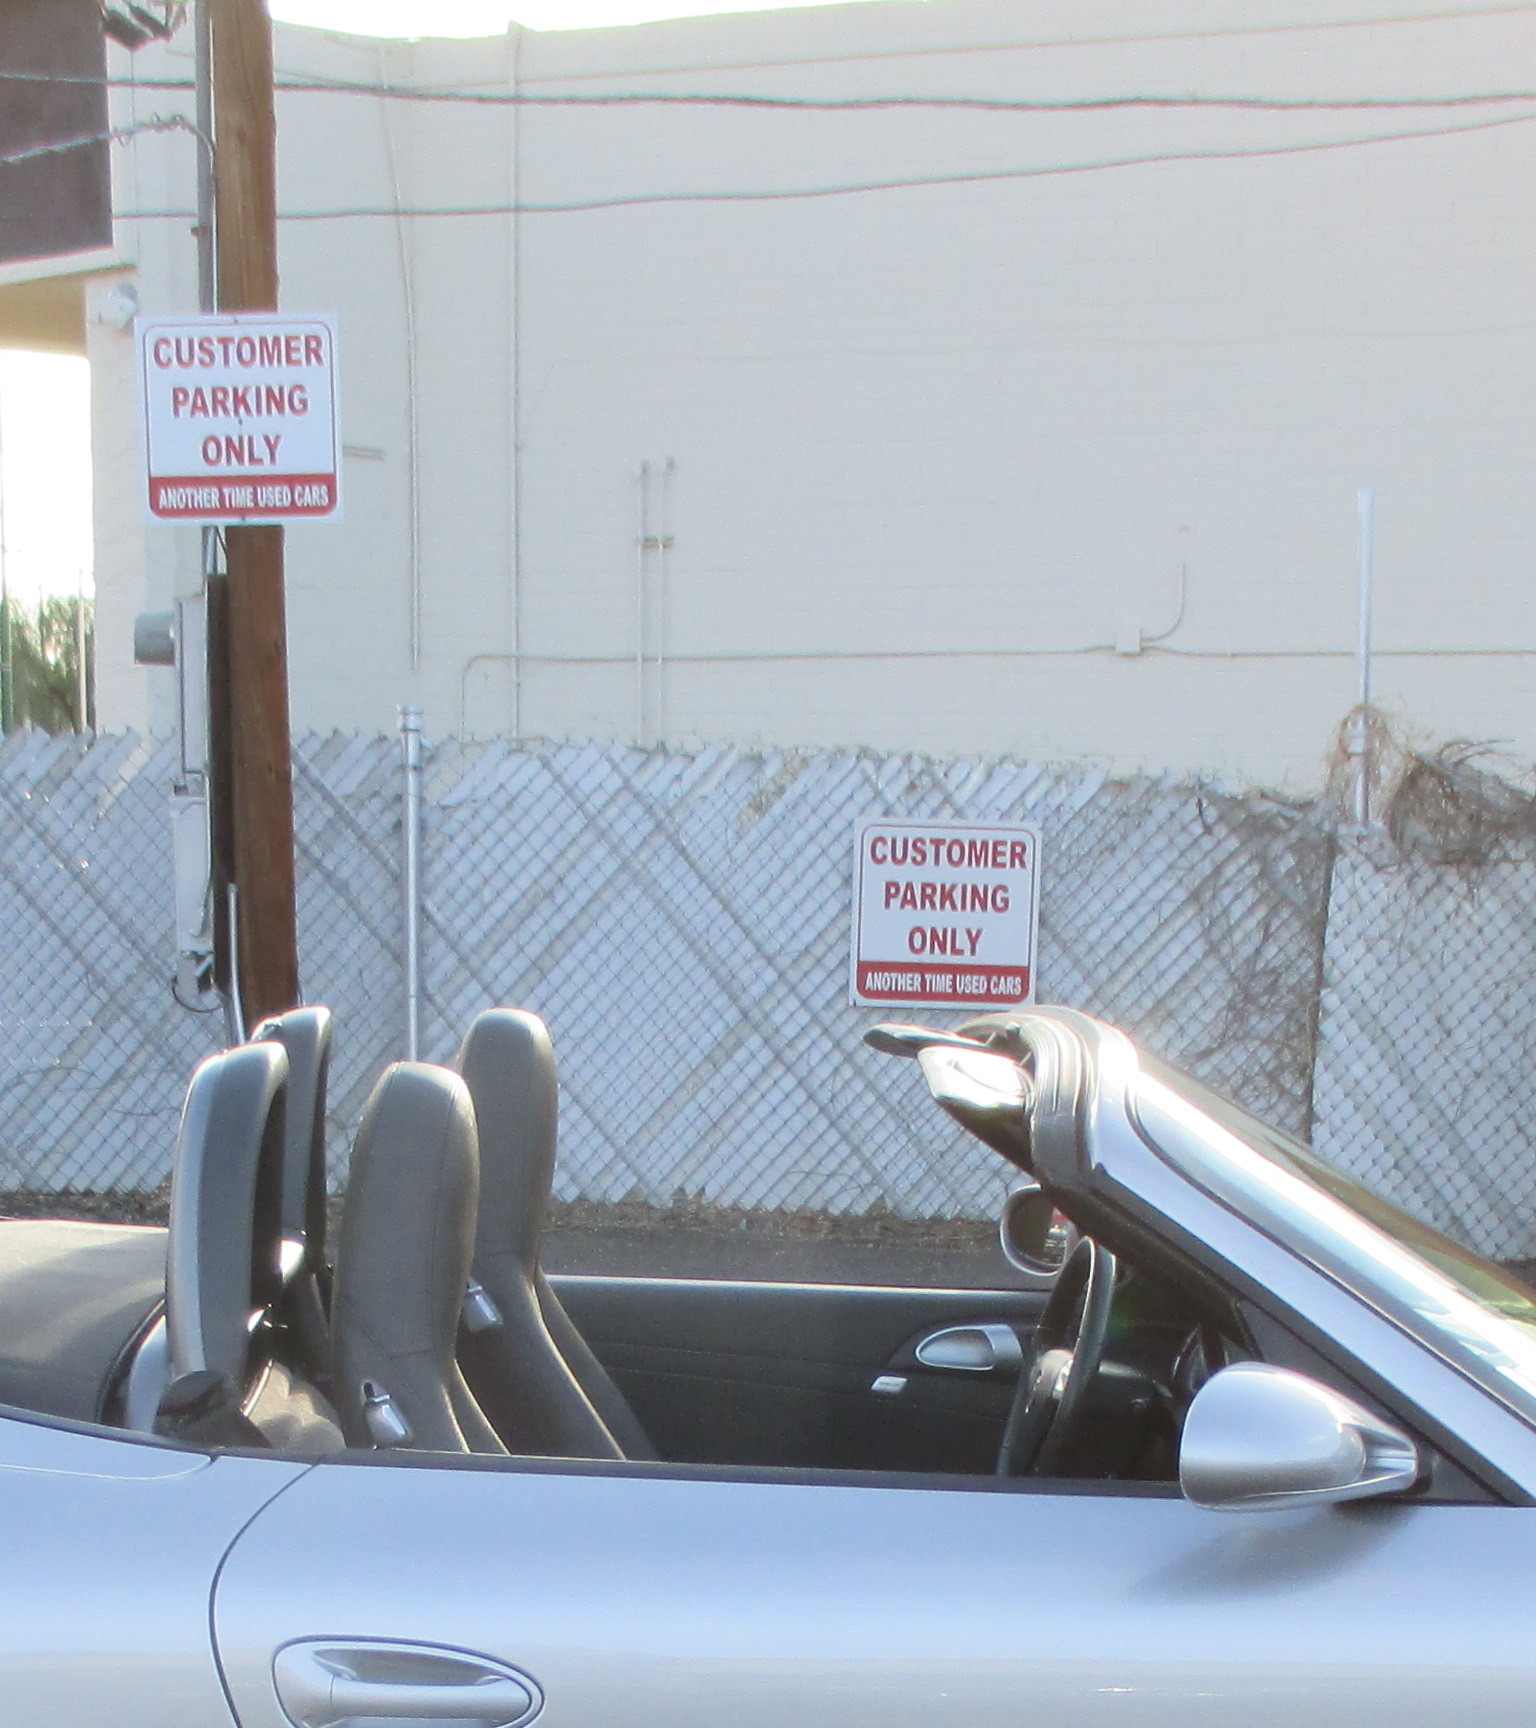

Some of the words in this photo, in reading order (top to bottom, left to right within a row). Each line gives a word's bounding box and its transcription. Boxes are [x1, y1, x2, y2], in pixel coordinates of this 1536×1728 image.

[153, 335, 325, 370] CUSTOMER
[172, 384, 309, 419] PARKING
[201, 434, 282, 467] ONLY
[159, 487, 220, 509] ANOTHER
[222, 486, 254, 508] TIME
[257, 485, 291, 508] USED
[294, 484, 329, 507] CARS
[870, 836, 1028, 869] CUSTOMER
[884, 881, 1010, 914] PARKING
[908, 926, 983, 956] ONLY
[865, 972, 921, 992] ANOTHER
[924, 973, 953, 993] TIME
[956, 974, 987, 994] USED
[990, 975, 1022, 995] CARS
